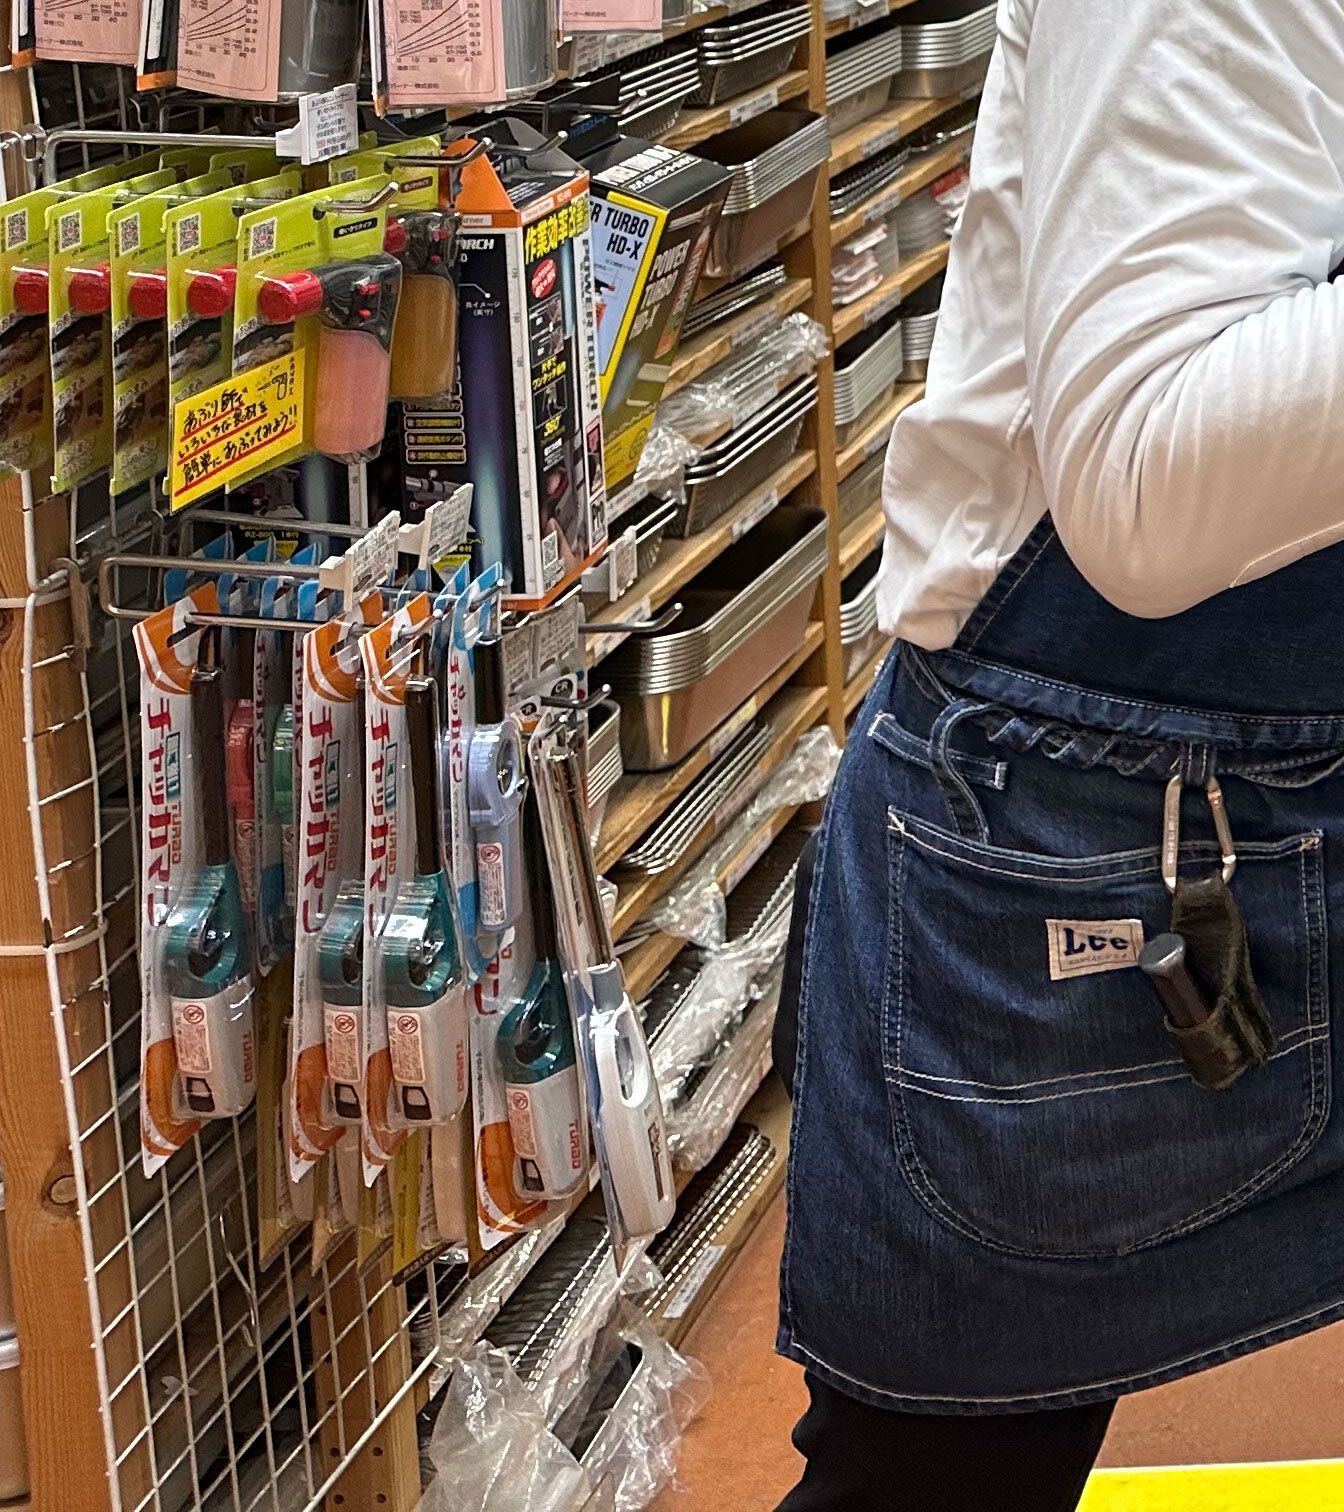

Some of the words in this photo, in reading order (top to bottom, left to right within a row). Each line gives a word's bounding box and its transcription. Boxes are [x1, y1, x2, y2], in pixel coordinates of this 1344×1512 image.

[606, 206, 650, 238] TURBO
[607, 236, 643, 261] HD-X
[1063, 927, 1129, 957] Lee
